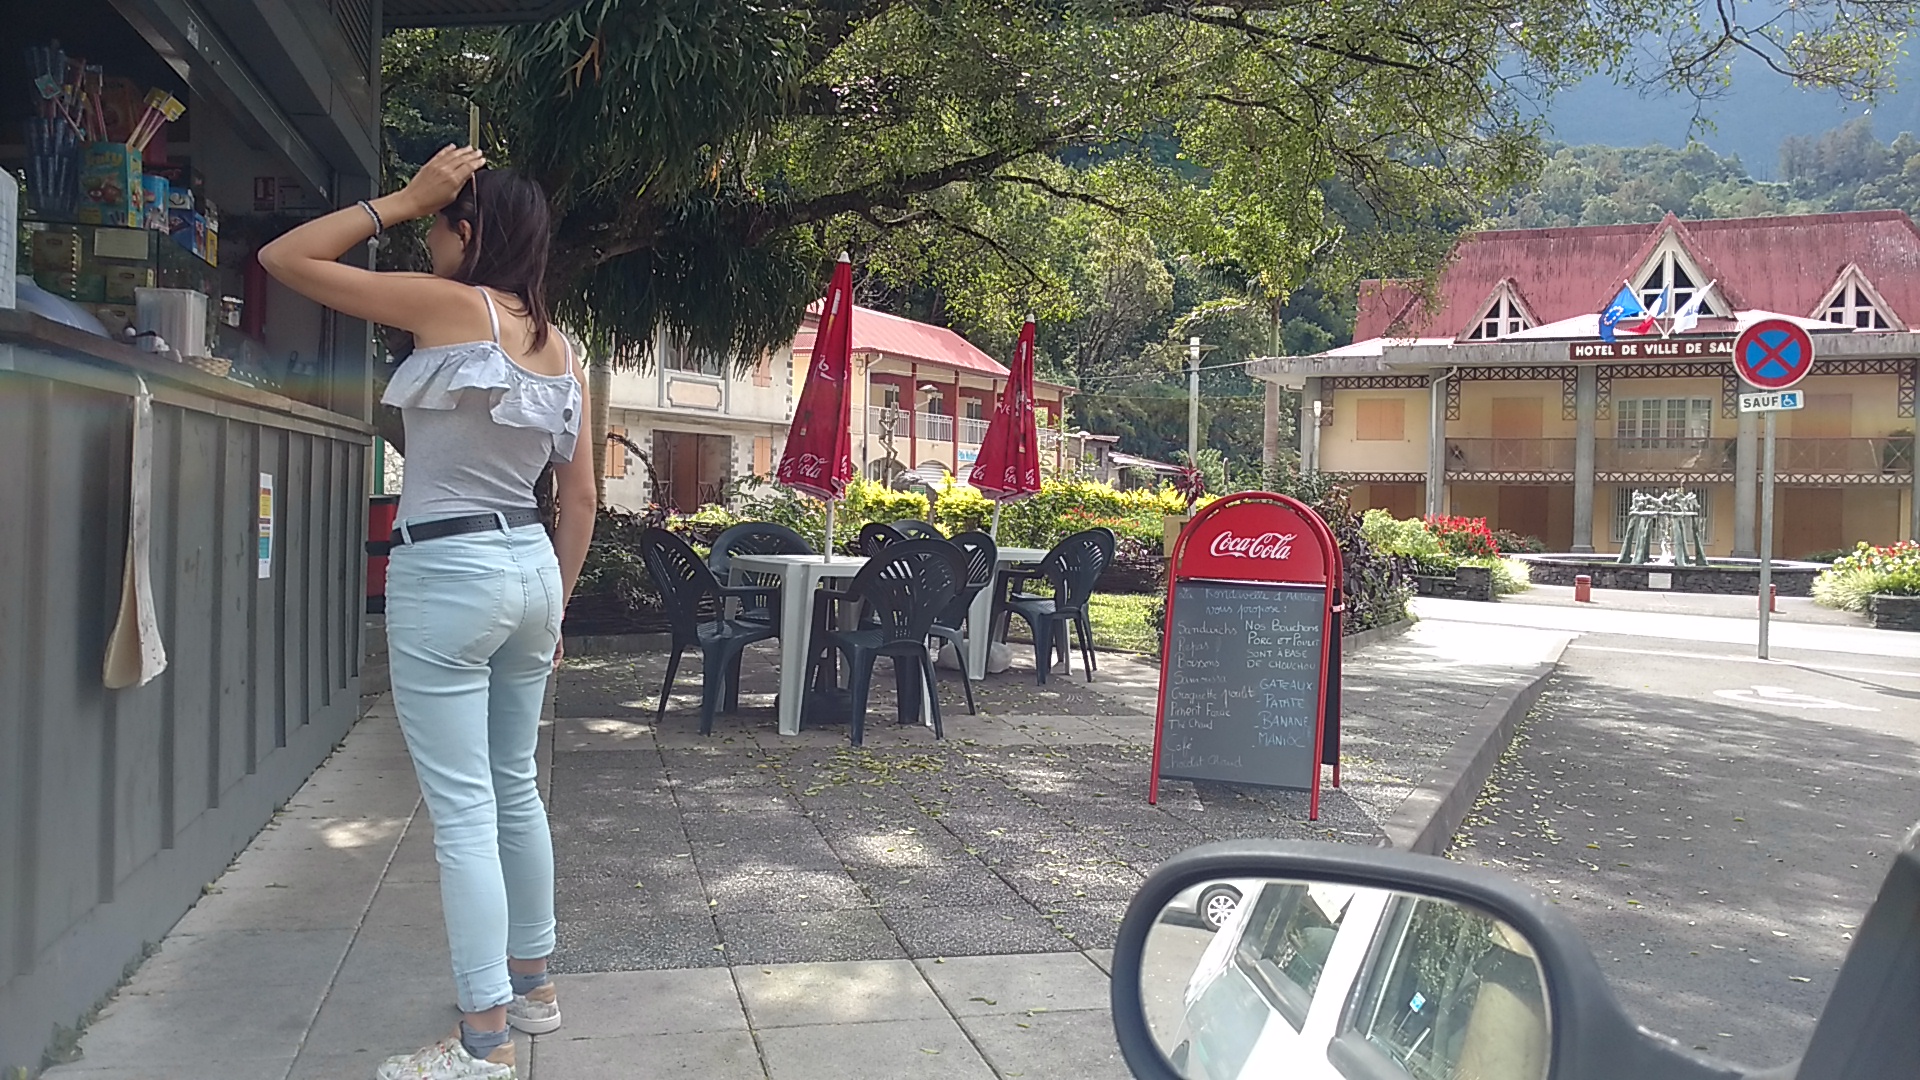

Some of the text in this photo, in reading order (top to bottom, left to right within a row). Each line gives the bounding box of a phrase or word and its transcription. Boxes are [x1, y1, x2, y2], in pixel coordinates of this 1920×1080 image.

[1575, 341, 1734, 356] HOTEL DE VILLE DE SAL
[1743, 396, 1779, 409] SAUF
[1210, 530, 1298, 560] Coca-Cola
[1205, 606, 1233, 615] vous
[1238, 604, 1281, 620] propose
[1177, 620, 1238, 635] Sandwichs
[1245, 618, 1319, 632] Nos Bouchons
[1178, 638, 1210, 656] Repas
[1246, 650, 1272, 659] SONT
[1285, 649, 1307, 659] BASE
[1246, 659, 1316, 670] DE CHOUCHOU
[1259, 678, 1313, 692] GATEAUX
[1258, 711, 1309, 729] BANANE
